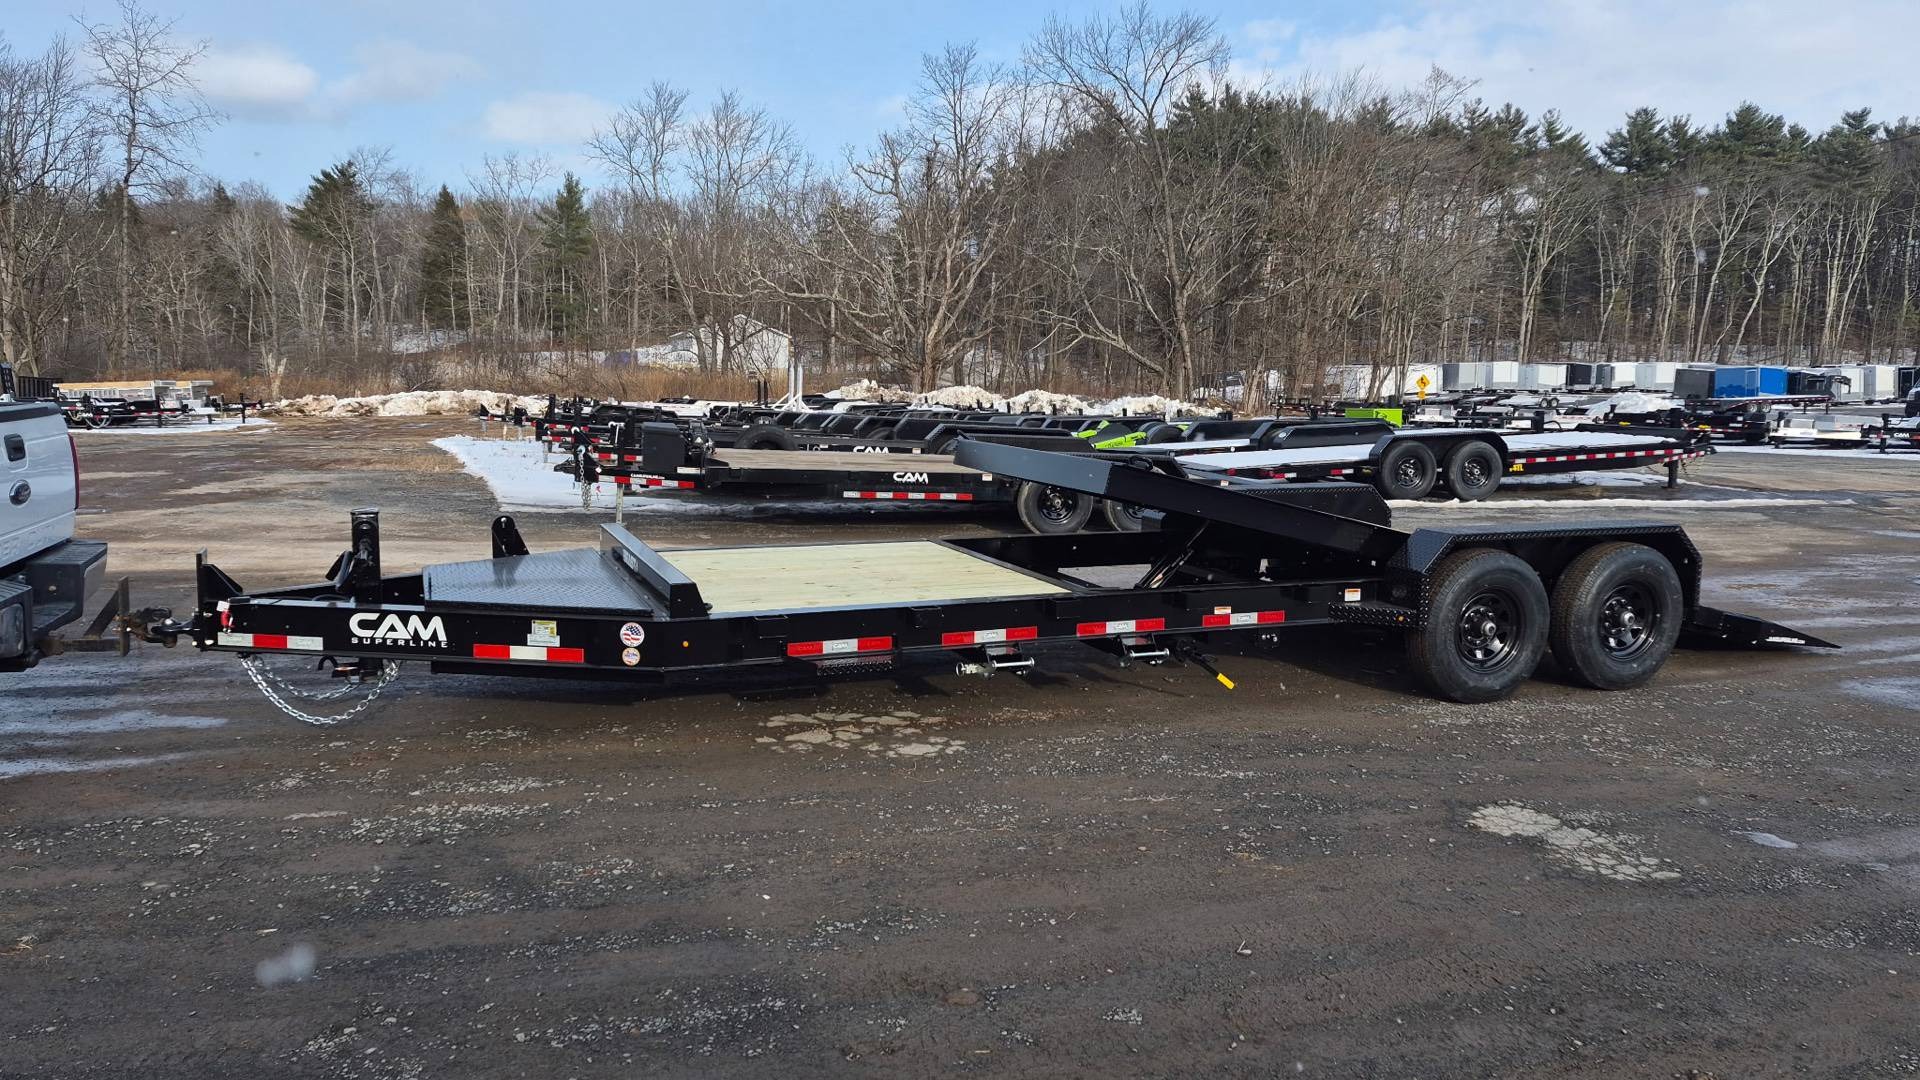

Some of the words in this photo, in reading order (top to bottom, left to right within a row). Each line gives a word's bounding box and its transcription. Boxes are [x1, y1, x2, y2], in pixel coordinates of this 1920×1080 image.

[893, 472, 929, 484] CAM
[349, 612, 447, 641] CAM
[351, 637, 448, 648] SUPERLINE
